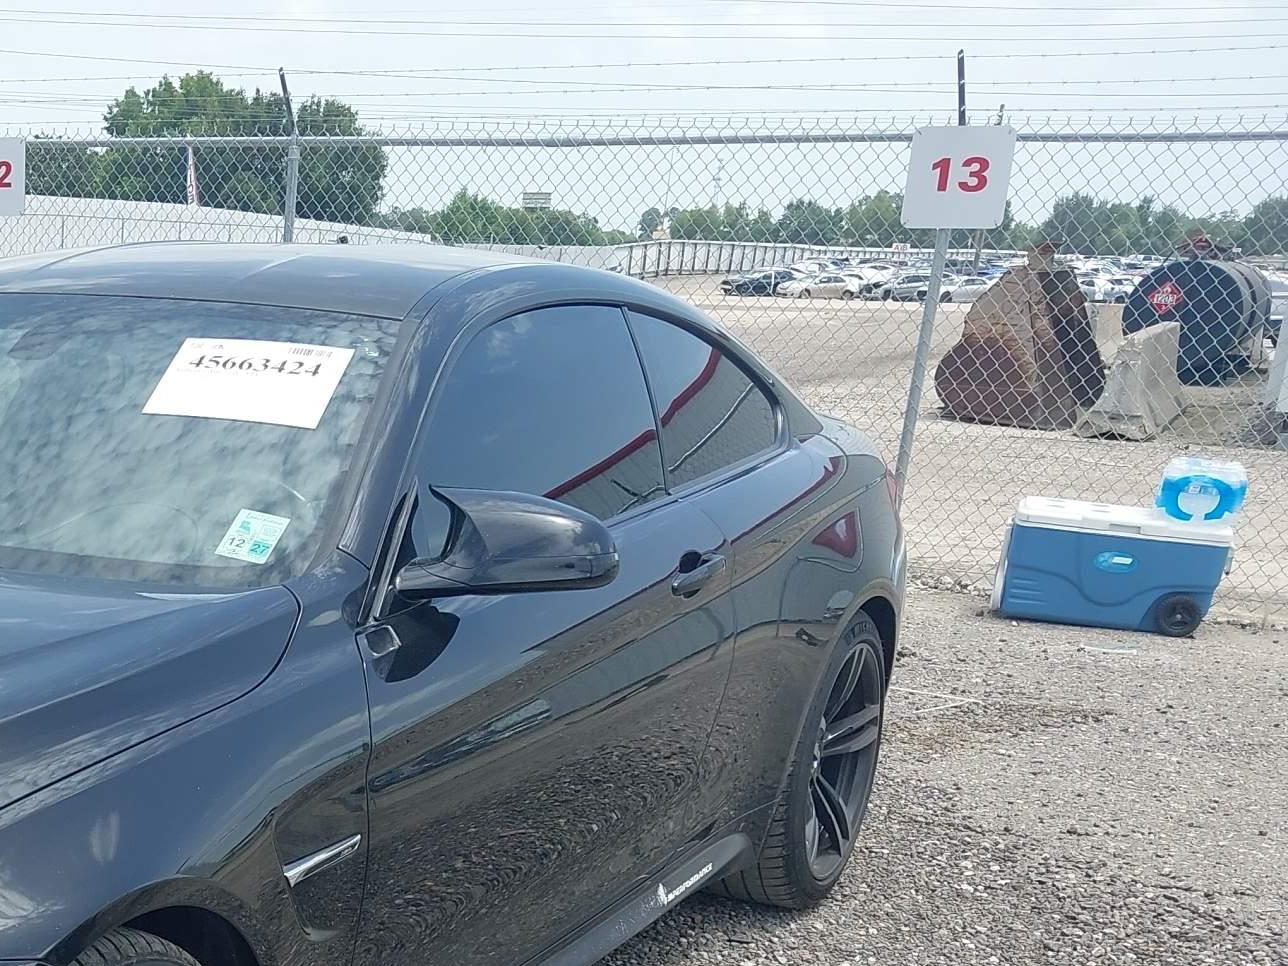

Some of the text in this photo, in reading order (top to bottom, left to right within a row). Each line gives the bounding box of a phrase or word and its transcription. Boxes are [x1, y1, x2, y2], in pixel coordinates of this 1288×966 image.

[931, 156, 991, 193] 13
[188, 354, 323, 377] 45663424
[229, 537, 246, 548] 12
[249, 543, 270, 554] 27
